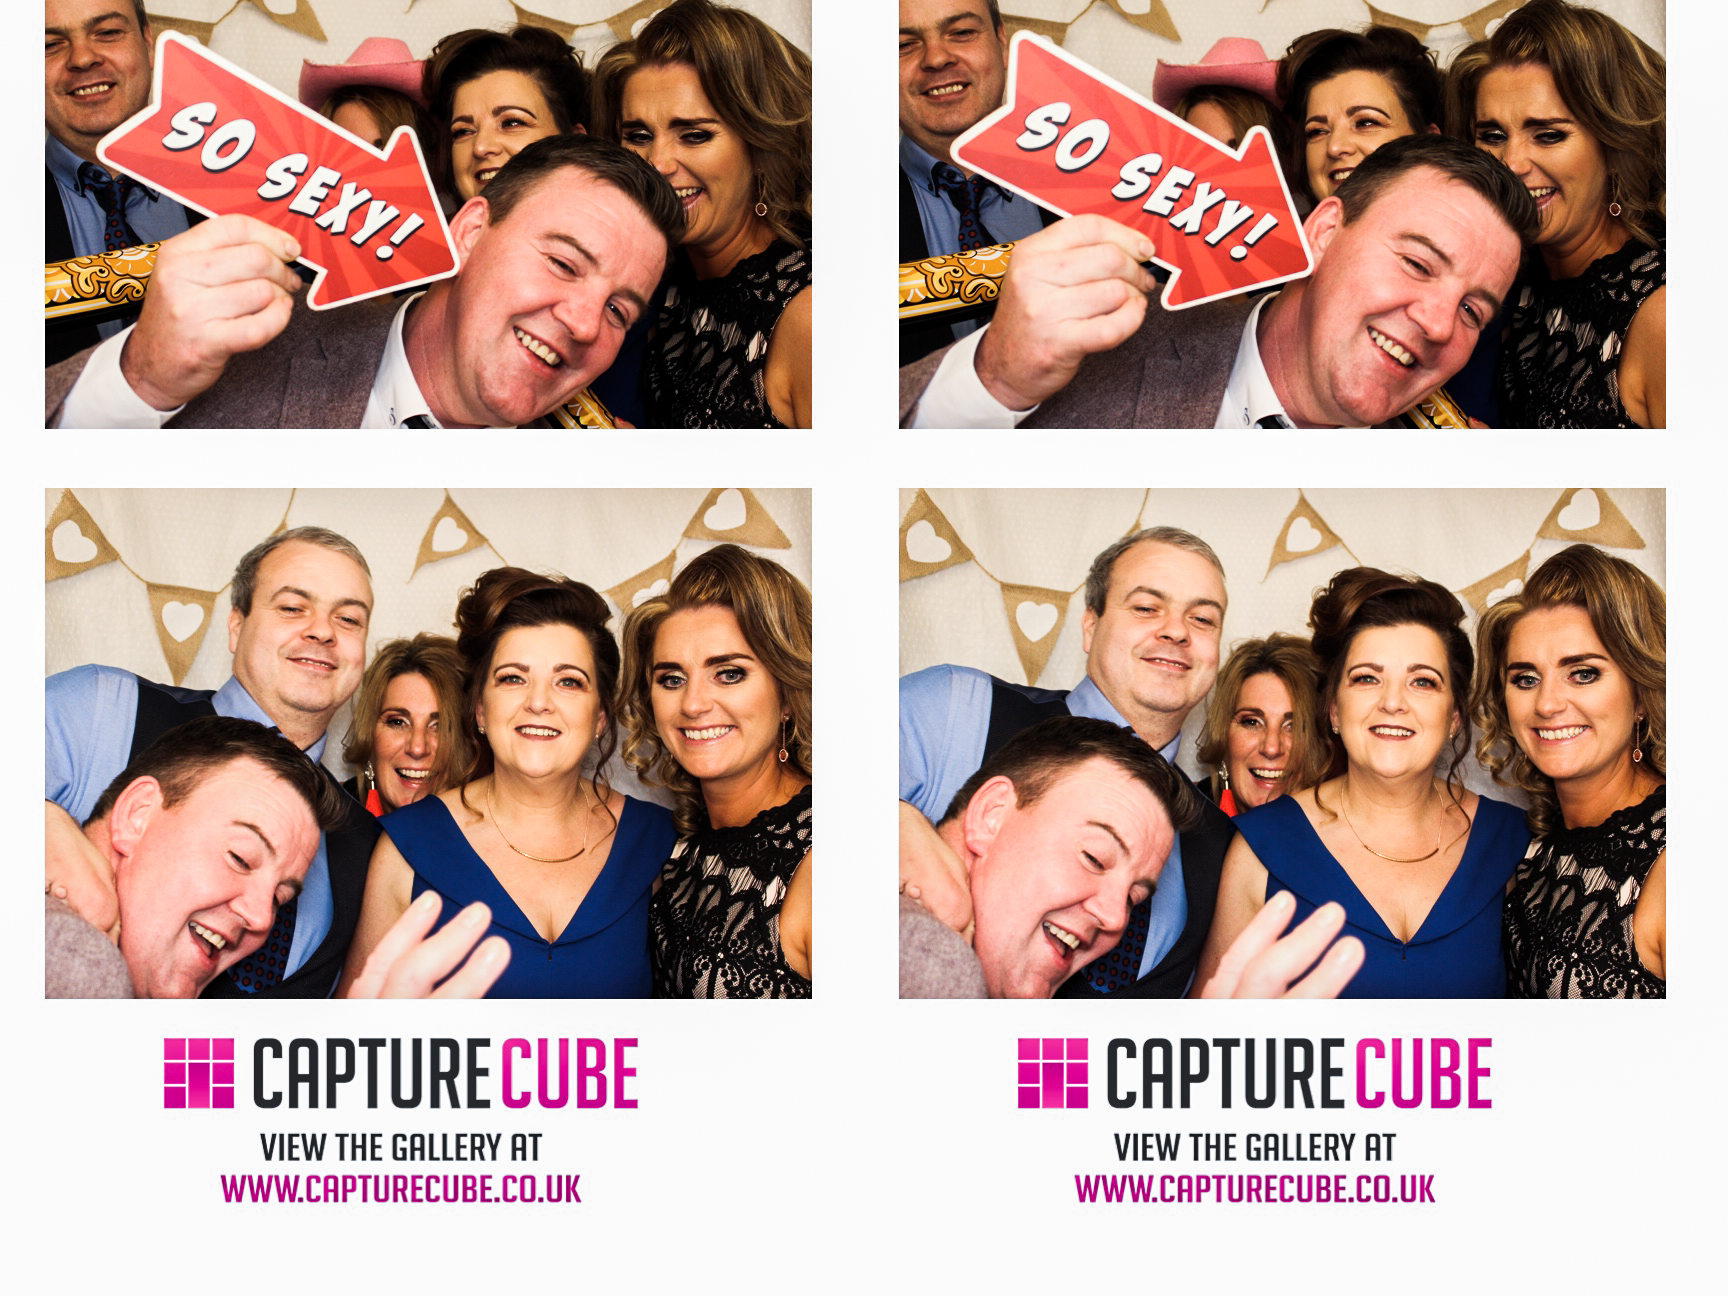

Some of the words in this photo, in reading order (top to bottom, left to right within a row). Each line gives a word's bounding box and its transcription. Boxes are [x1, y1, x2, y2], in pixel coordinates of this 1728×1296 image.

[161, 101, 257, 174] SO
[256, 152, 425, 263] SEXY!
[1015, 101, 1111, 174] SO
[1110, 152, 1279, 263] SEXY!
